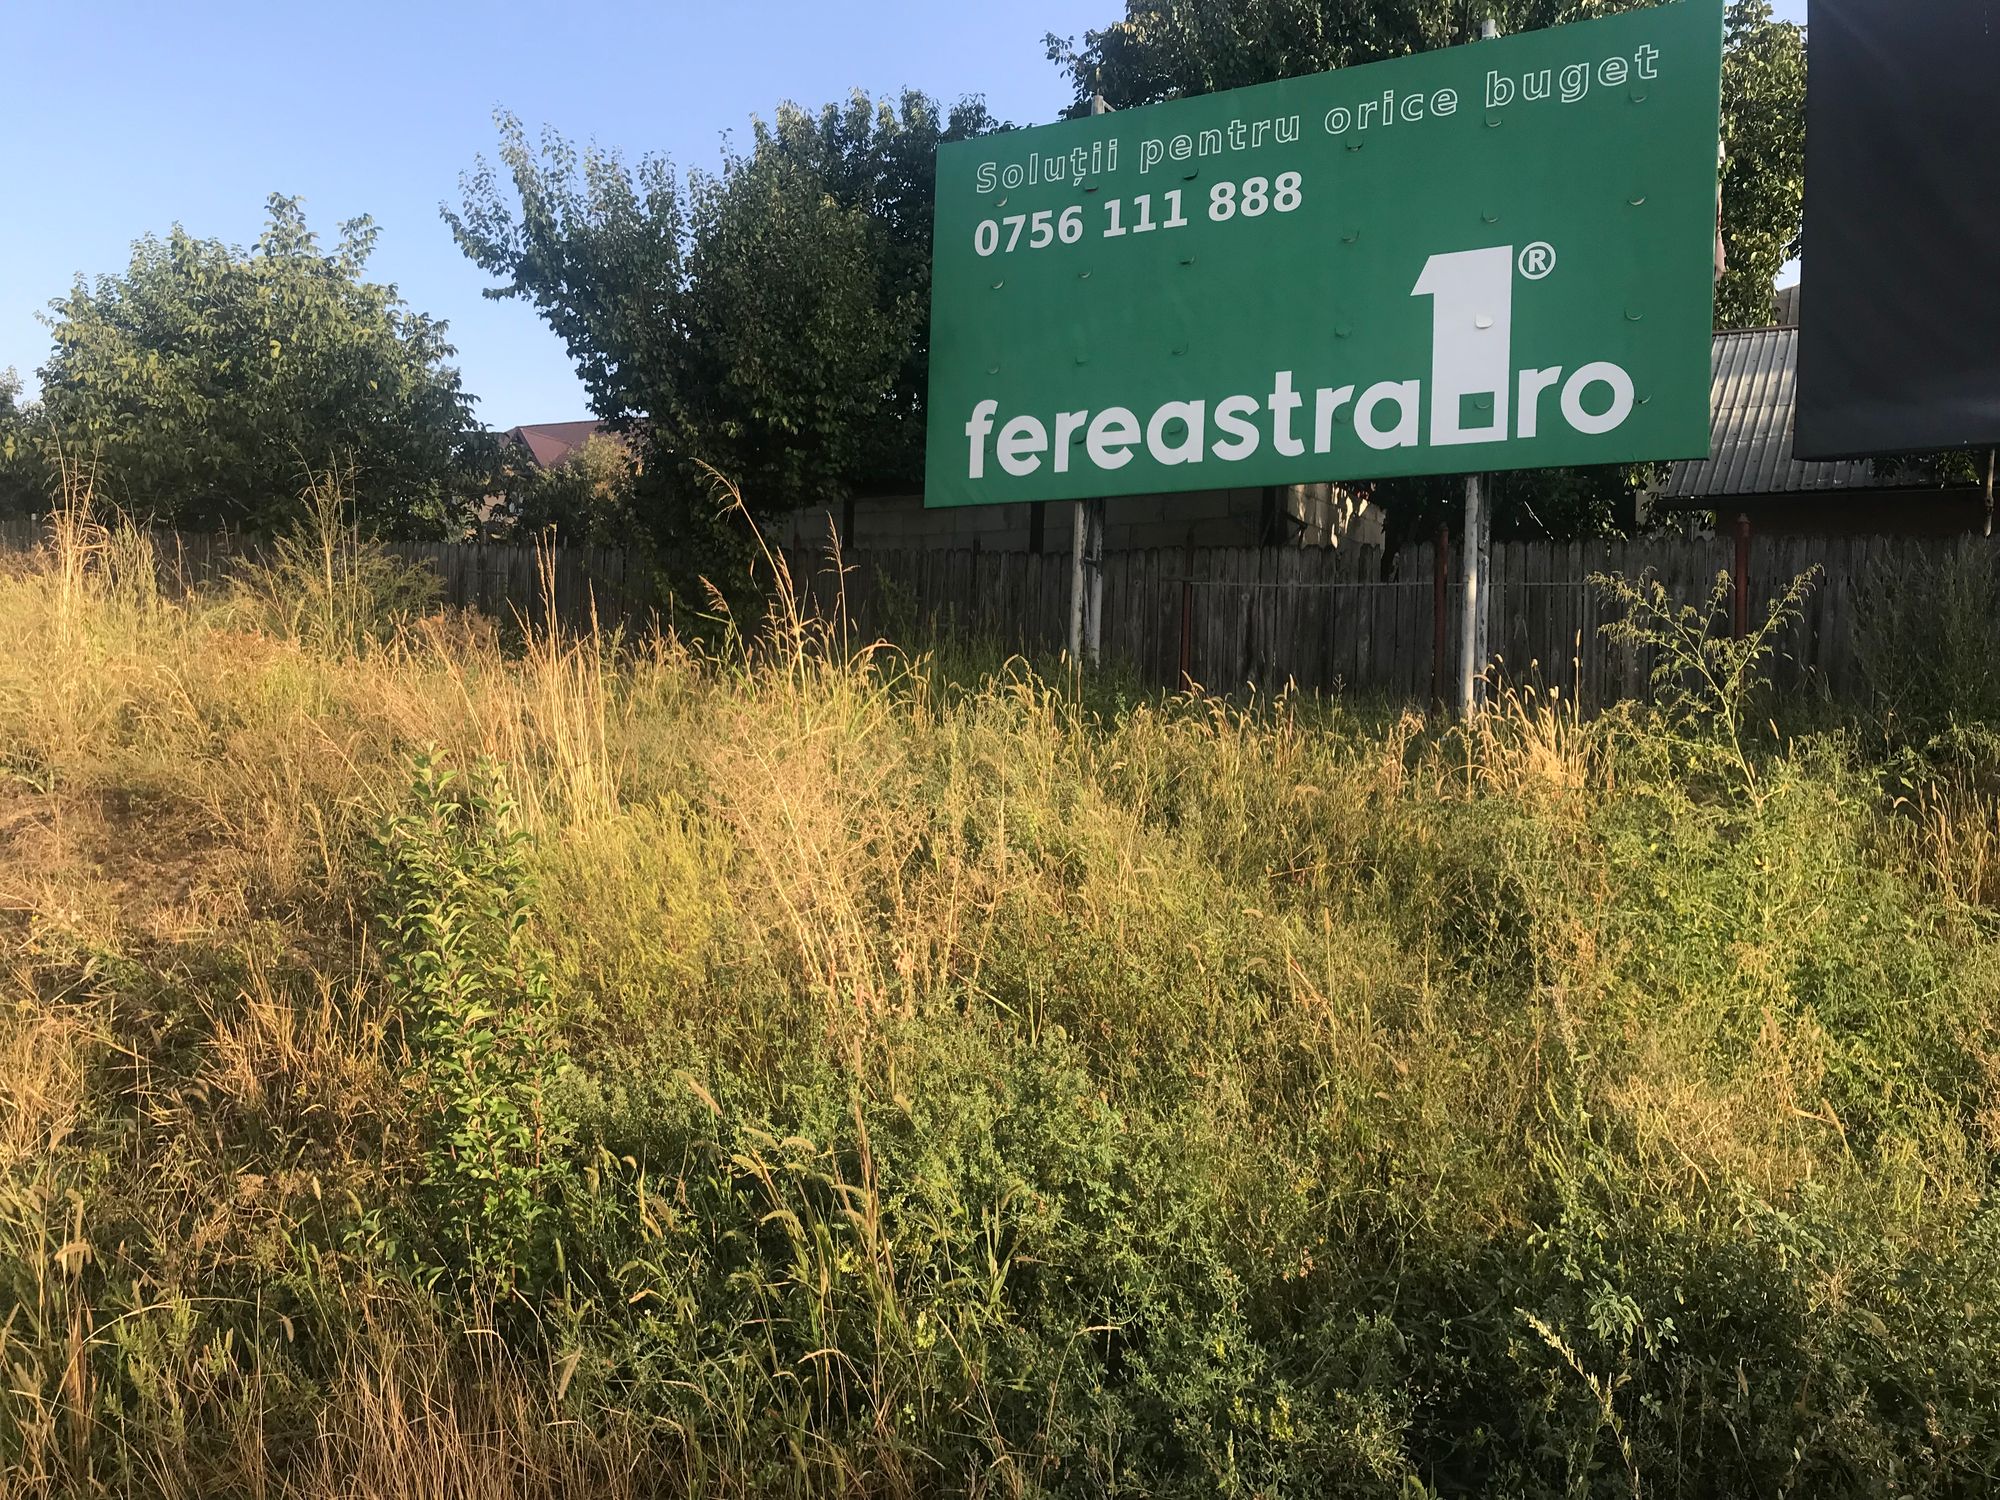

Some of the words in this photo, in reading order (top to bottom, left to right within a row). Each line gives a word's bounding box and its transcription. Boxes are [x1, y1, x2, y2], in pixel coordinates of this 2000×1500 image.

[1140, 115, 1300, 174] pentru
[1324, 88, 1458, 135] orice
[1485, 43, 1659, 108] buget
[974, 205, 1084, 257] 0756
[1103, 189, 1188, 238] 111
[1208, 171, 1303, 222] 888
